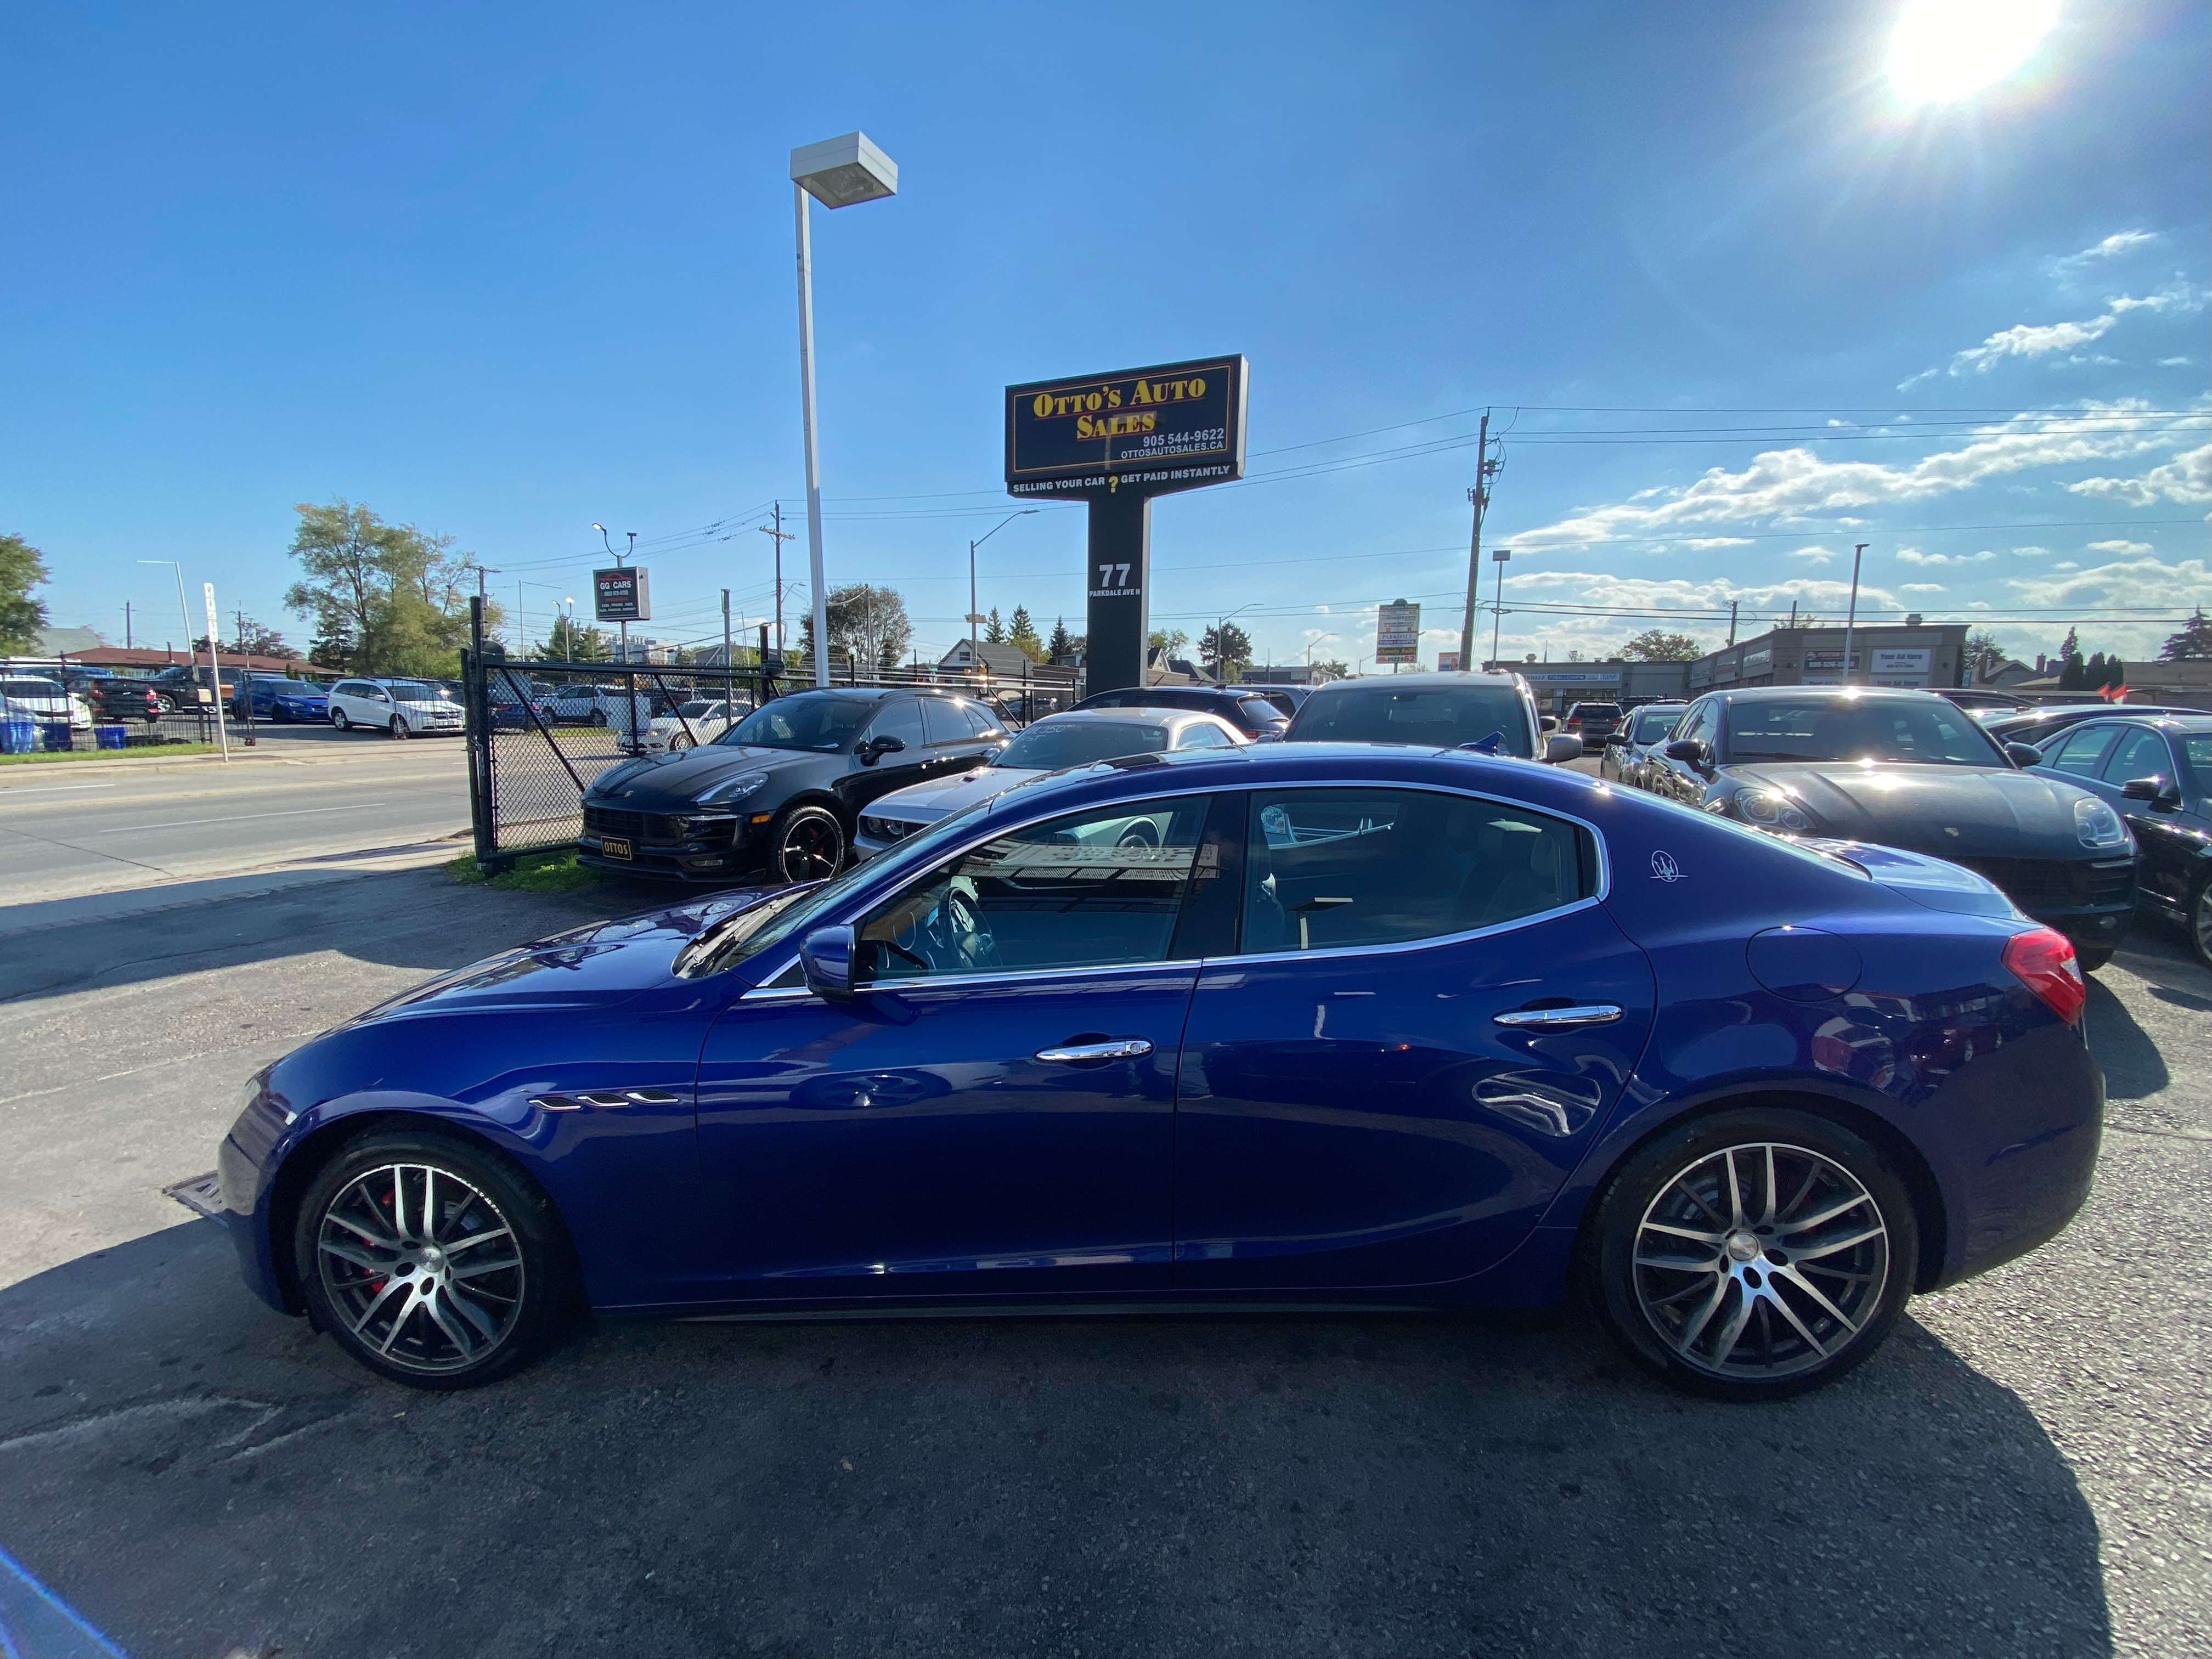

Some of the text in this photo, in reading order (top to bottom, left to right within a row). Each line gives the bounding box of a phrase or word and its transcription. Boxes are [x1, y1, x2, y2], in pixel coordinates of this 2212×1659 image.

[1130, 379, 1206, 405] AUTO
[1077, 413, 1155, 439] SALES
[1143, 428, 1224, 447] 905 544-9622
[1121, 441, 1223, 459] OTTOSAUTOSALES.CA
[1013, 482, 1053, 492] SELLING
[1055, 479, 1082, 489] YOUR
[1084, 477, 1105, 486] CAR
[1121, 473, 1141, 483] GET
[1143, 471, 1168, 482] PAID
[1171, 465, 1231, 479] INSTANTLY
[613, 580, 631, 589] CARS
[1099, 563, 1131, 587] 77
[604, 842, 628, 855] OTTOS
